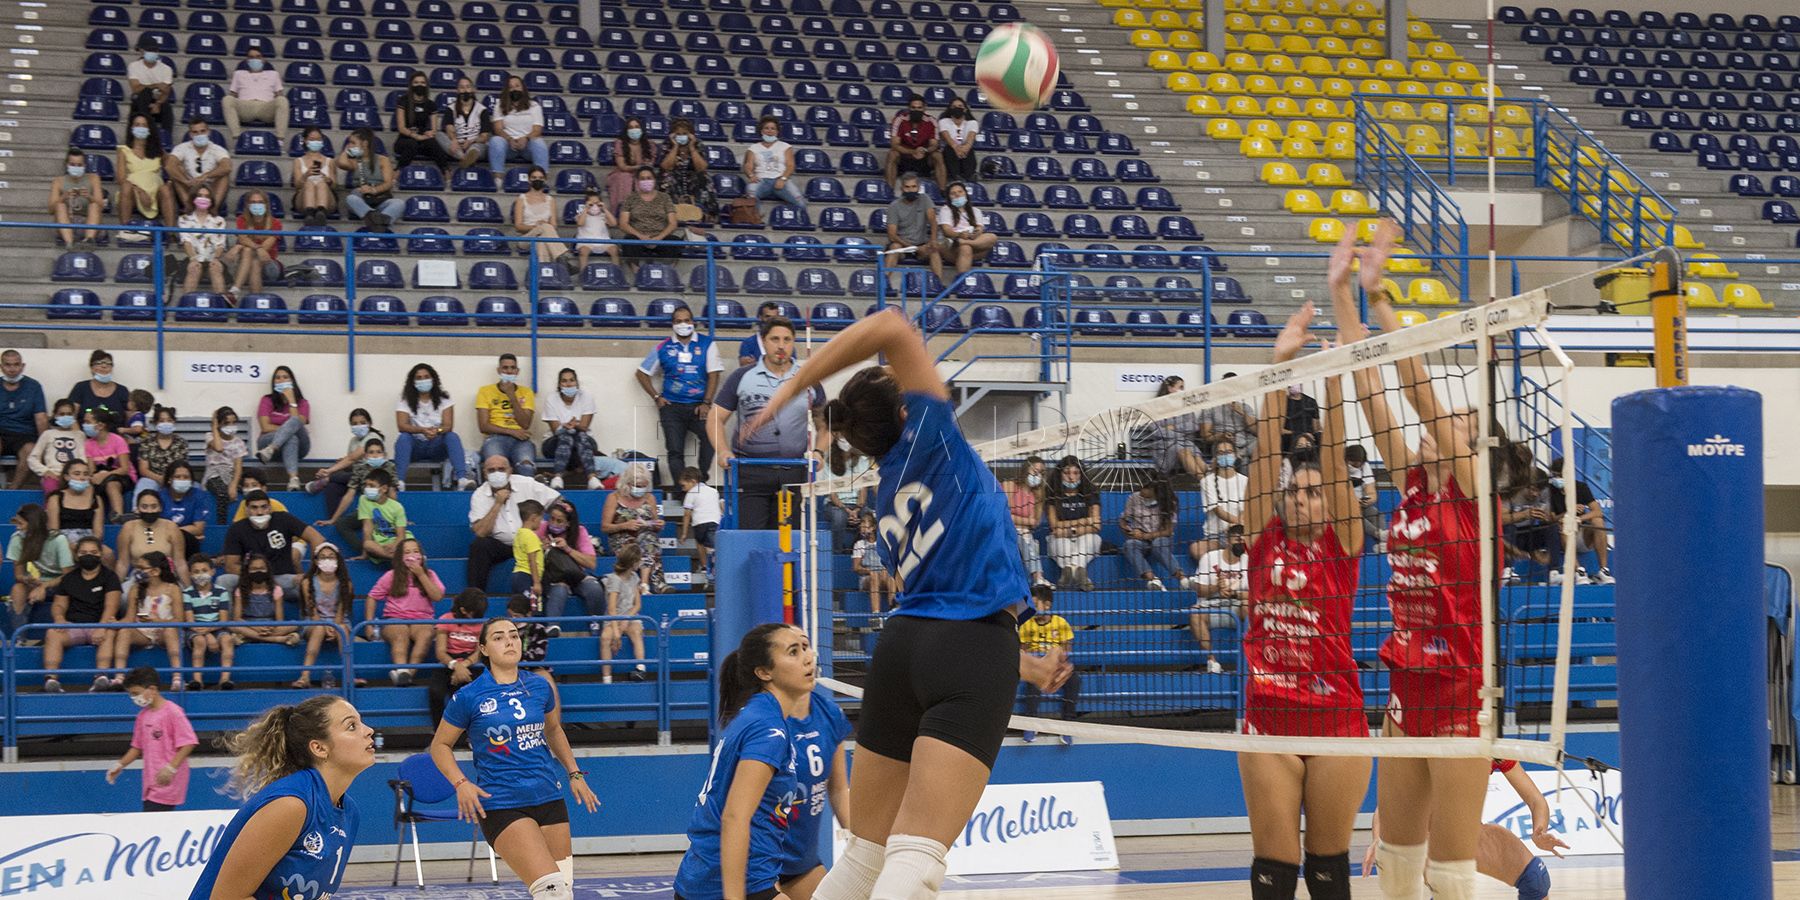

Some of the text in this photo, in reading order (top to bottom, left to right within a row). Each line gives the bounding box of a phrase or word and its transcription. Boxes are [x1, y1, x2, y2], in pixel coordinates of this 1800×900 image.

[191, 363, 260, 378] SECTOR 3
[1121, 374, 1165, 383] SECTOR
[1687, 444, 1745, 457] MOYPE
[879, 481, 945, 580] 22
[508, 698, 526, 720] 3
[806, 744, 824, 777] 6
[965, 795, 1078, 847] Melilla
[1576, 817, 1590, 831] A
[0, 824, 226, 896] EN A Melill
[329, 846, 343, 885] 1
